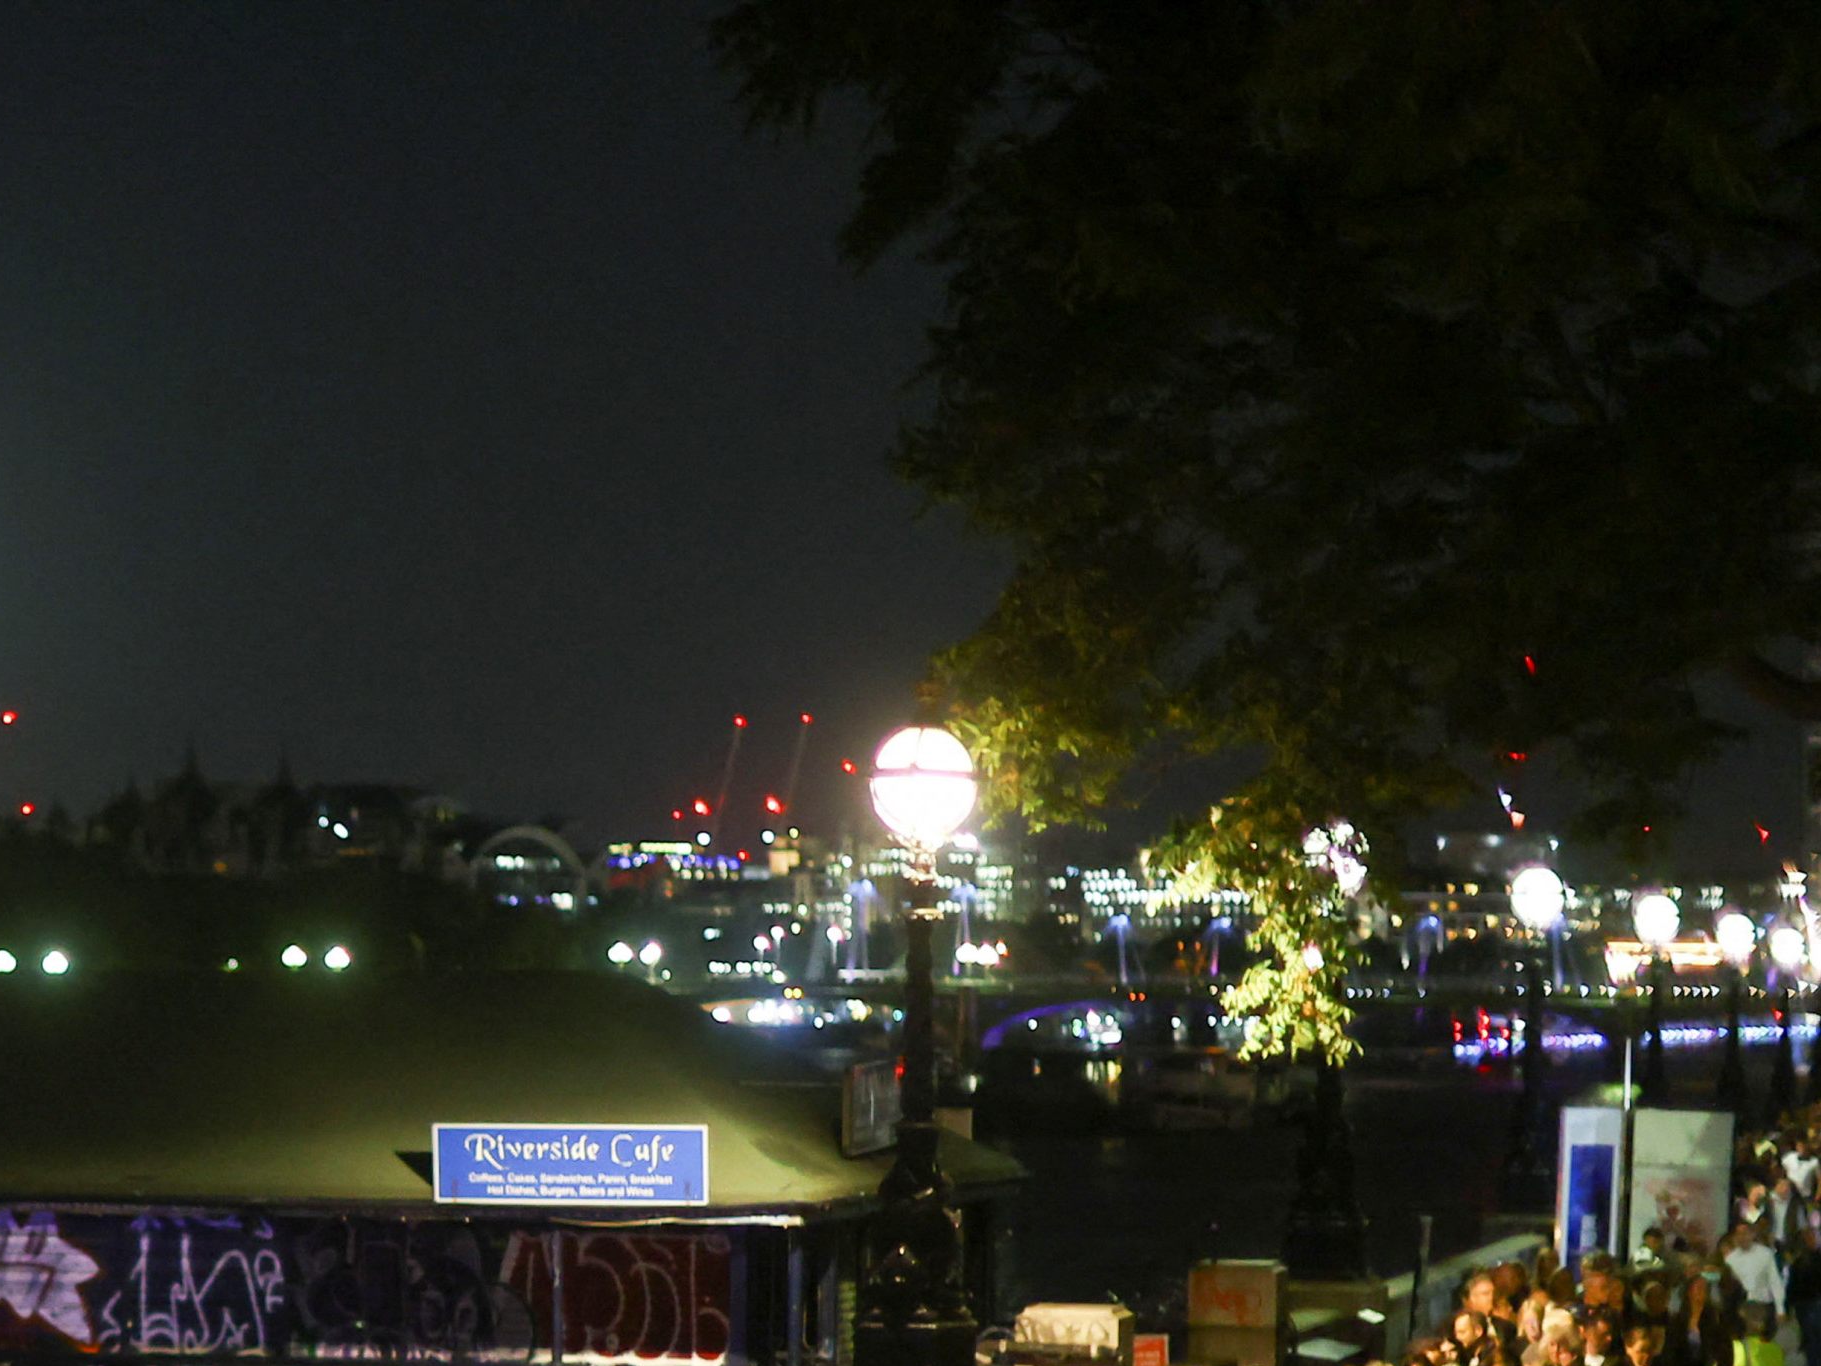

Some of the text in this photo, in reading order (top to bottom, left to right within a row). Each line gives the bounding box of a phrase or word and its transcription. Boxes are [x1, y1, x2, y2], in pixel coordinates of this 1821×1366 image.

[464, 1133, 675, 1174] Riverside Cafe
[630, 1173, 673, 1184] Breakfast
[487, 1185, 504, 1194] Hot
[579, 1185, 606, 1196] Beers
[607, 1186, 625, 1197] and
[626, 1186, 655, 1196] Wines
